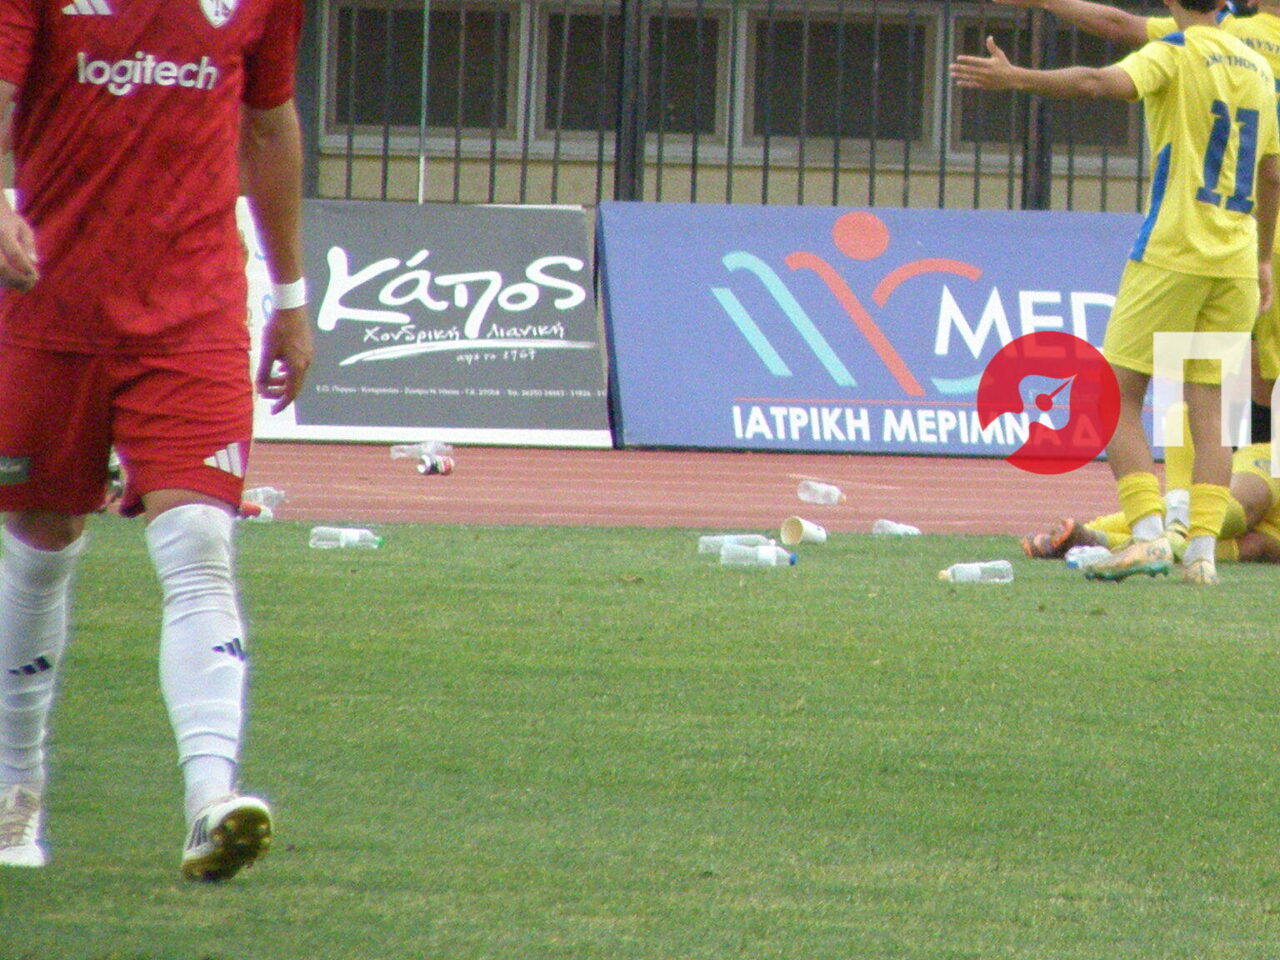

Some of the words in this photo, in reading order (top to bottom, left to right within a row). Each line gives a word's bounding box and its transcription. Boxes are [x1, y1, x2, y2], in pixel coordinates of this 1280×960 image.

[77, 50, 218, 96] logitech
[1195, 98, 1260, 214] 11
[363, 324, 460, 345] Χονδρική
[486, 321, 565, 339] Λιανική
[732, 405, 871, 441] ΙΑΤΡΙΚΗ
[883, 408, 1061, 447] ΜΕΡΙΜΝΑ
